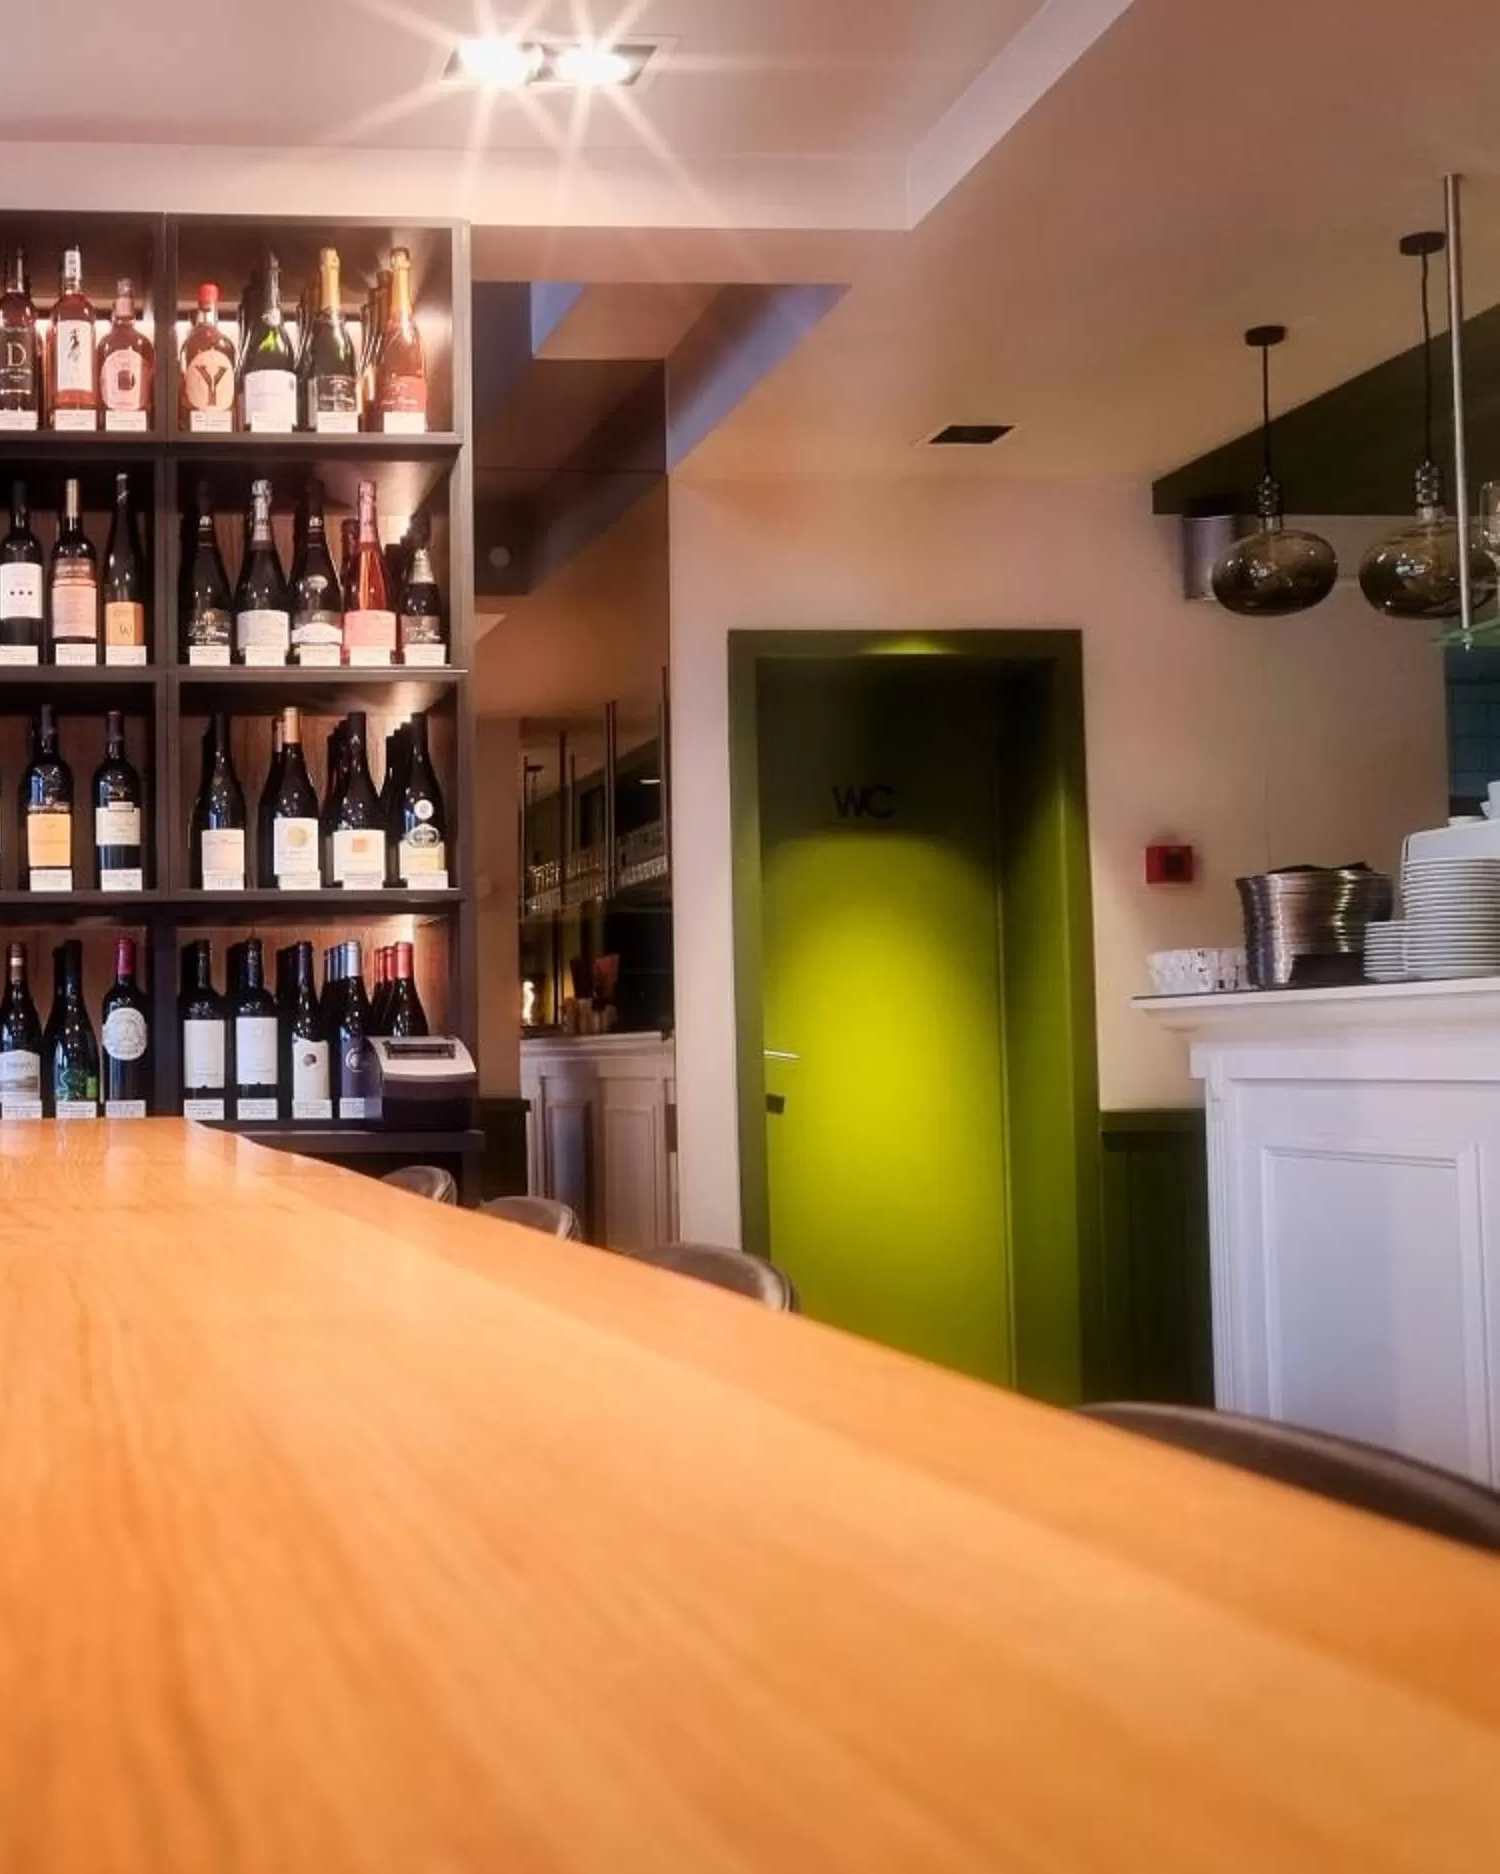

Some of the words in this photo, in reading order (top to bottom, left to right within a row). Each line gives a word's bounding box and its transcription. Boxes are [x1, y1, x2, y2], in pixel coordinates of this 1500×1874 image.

[7, 342, 27, 367] D
[195, 364, 228, 406] Y
[832, 784, 896, 819] WC
